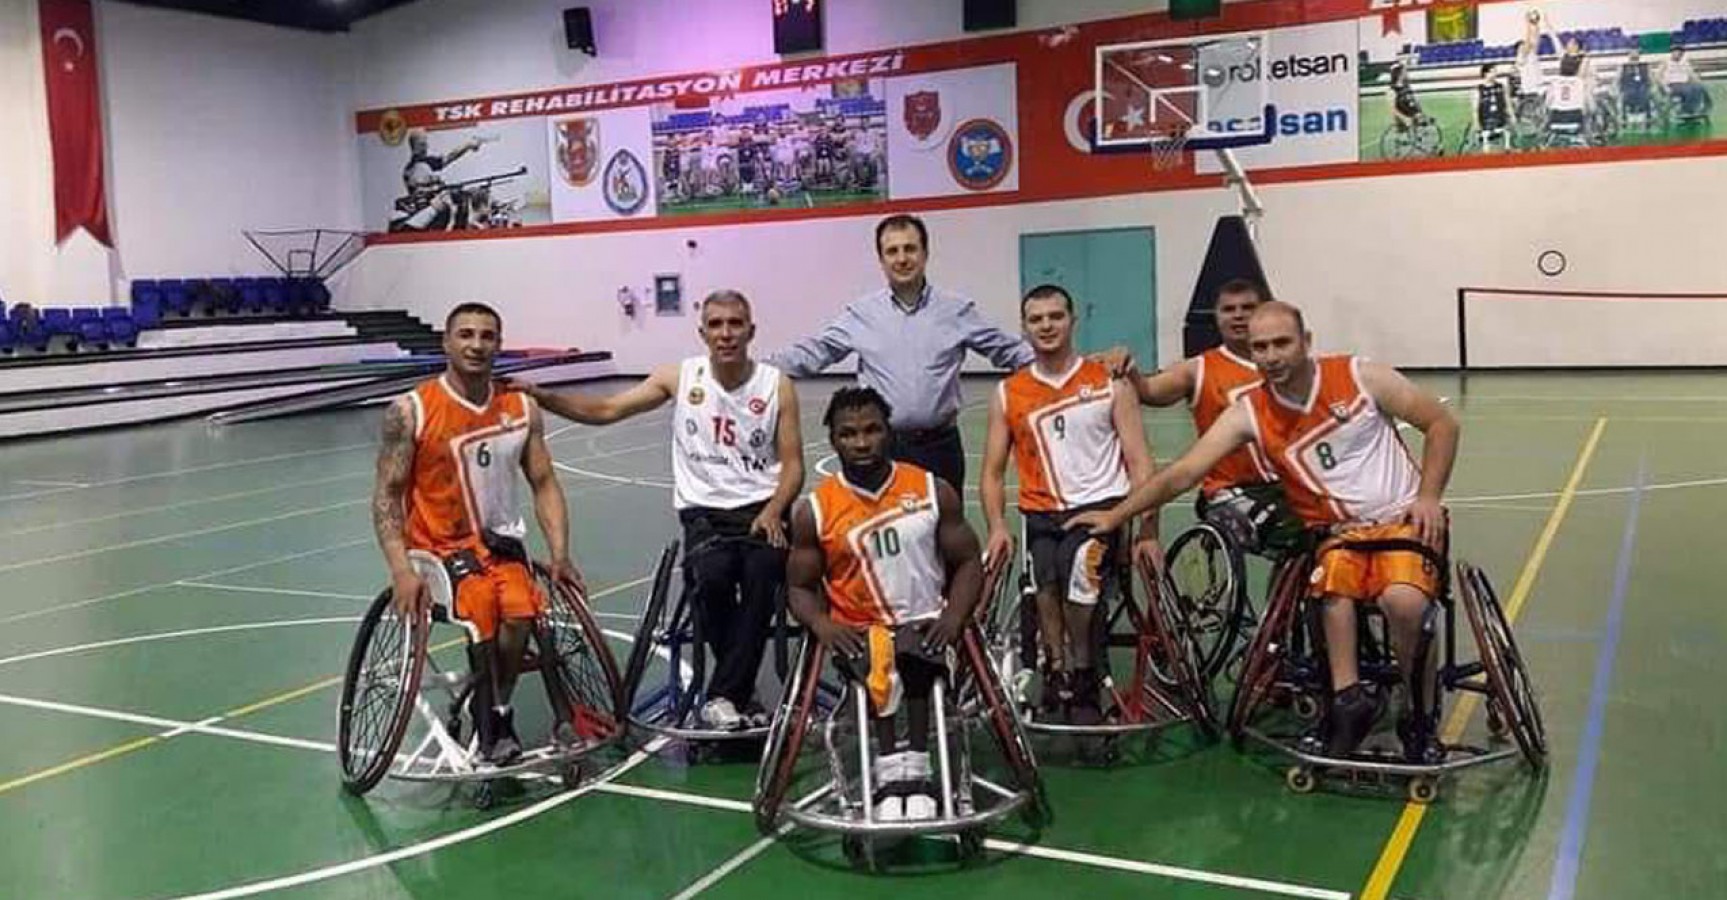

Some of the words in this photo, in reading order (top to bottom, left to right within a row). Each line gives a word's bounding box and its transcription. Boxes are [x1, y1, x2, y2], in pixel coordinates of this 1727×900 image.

[435, 103, 483, 120] TSK
[491, 70, 743, 115] REHABİLİTASYON
[752, 50, 902, 86] MERKEZİ
[712, 416, 737, 447] 15
[1054, 415, 1066, 440] 9
[477, 442, 491, 468] 6
[1315, 442, 1336, 470] 8
[870, 527, 901, 559] 10
